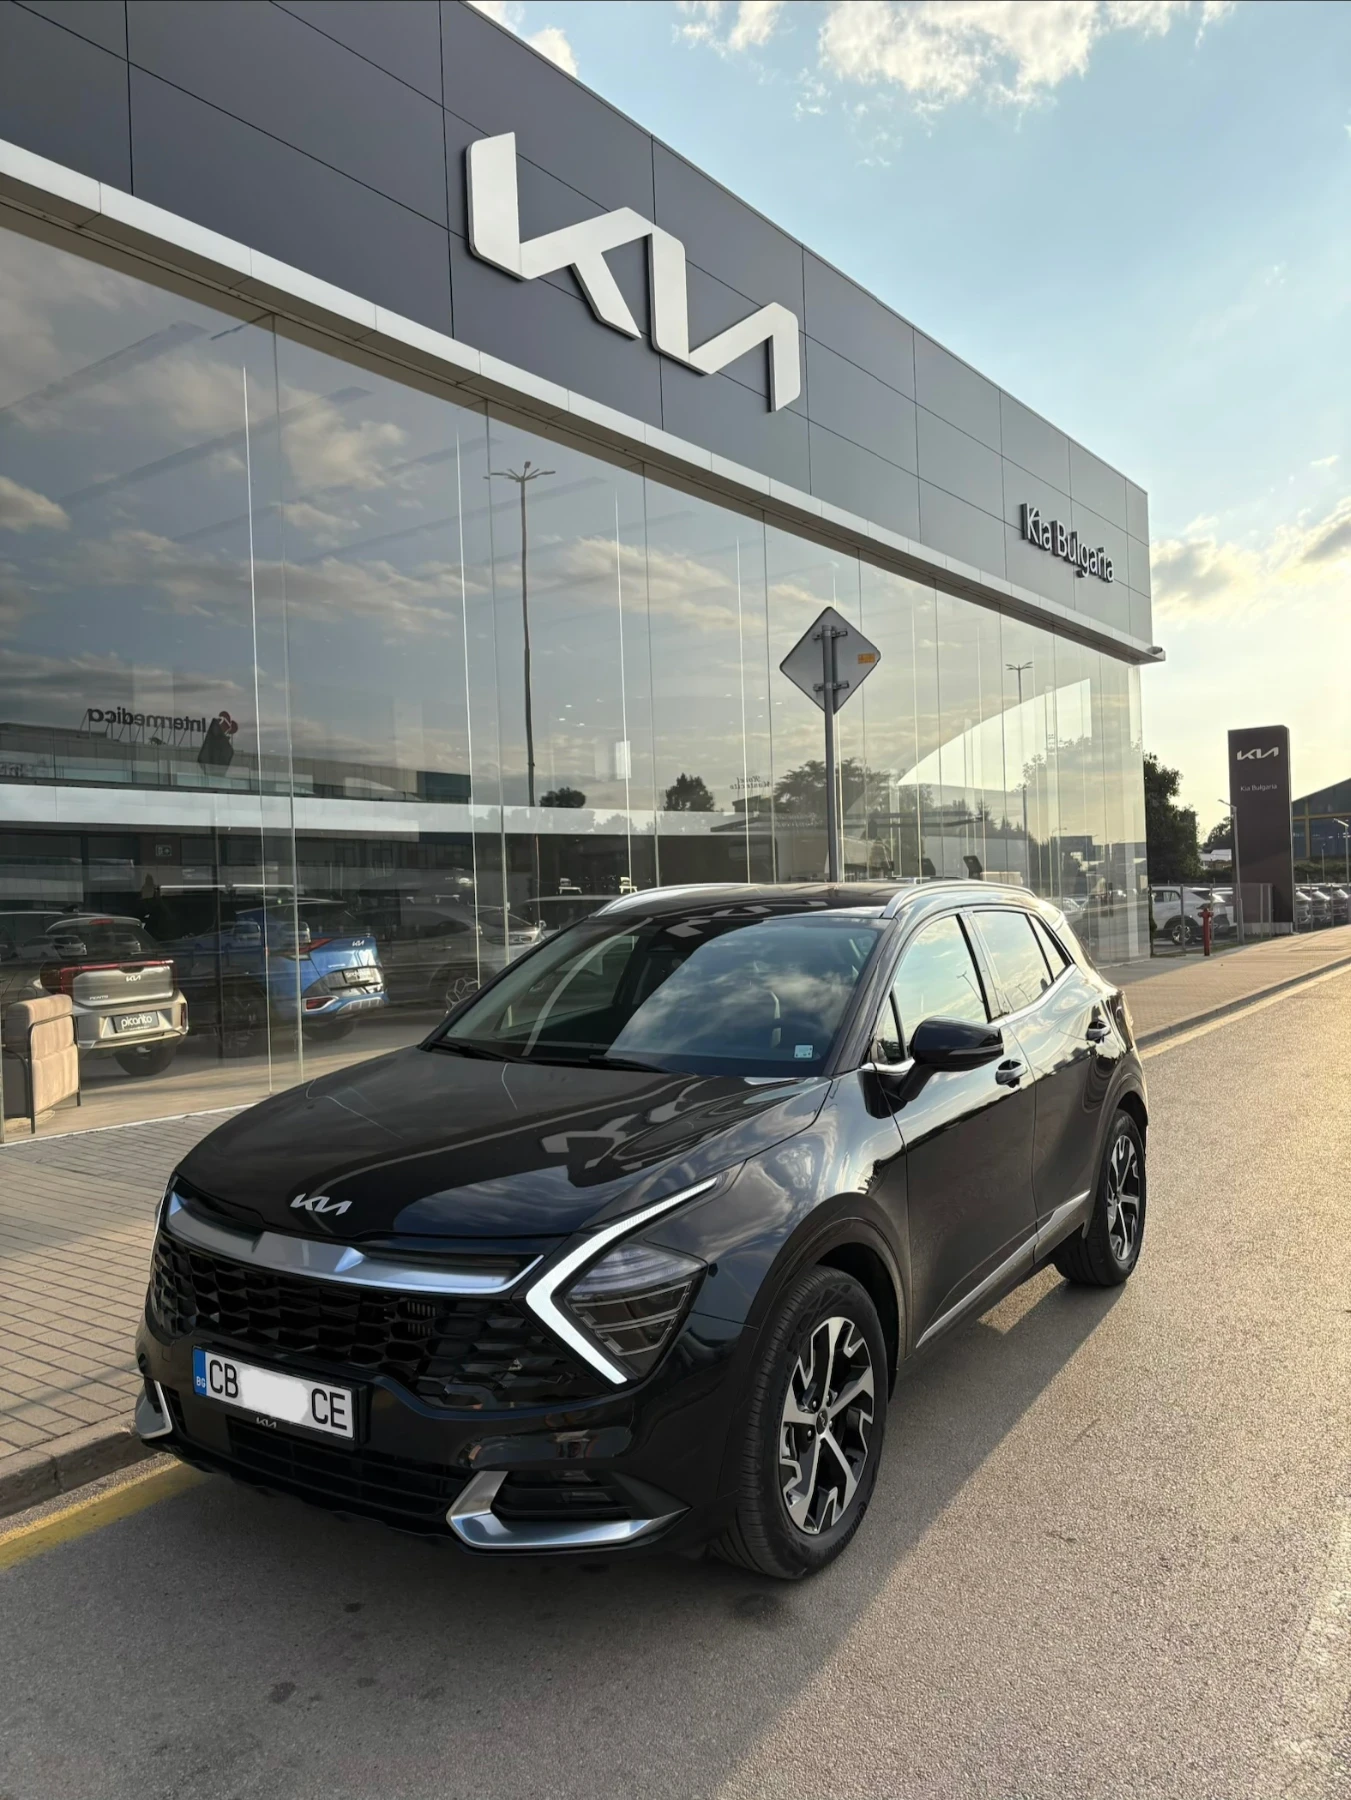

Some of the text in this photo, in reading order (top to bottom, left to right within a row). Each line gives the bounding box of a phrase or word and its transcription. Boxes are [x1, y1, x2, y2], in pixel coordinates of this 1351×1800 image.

[465, 131, 801, 413] KIA
[1021, 503, 1115, 582] Kia Bulgaria
[1236, 746, 1279, 761] KIA
[1251, 784, 1278, 792] Bulgaria
[125, 974, 142, 982] KIA
[290, 1193, 353, 1216] KIA
[196, 1376, 206, 1388] BG
[209, 1359, 348, 1431] CB CE
[256, 1416, 277, 1429] KIA
